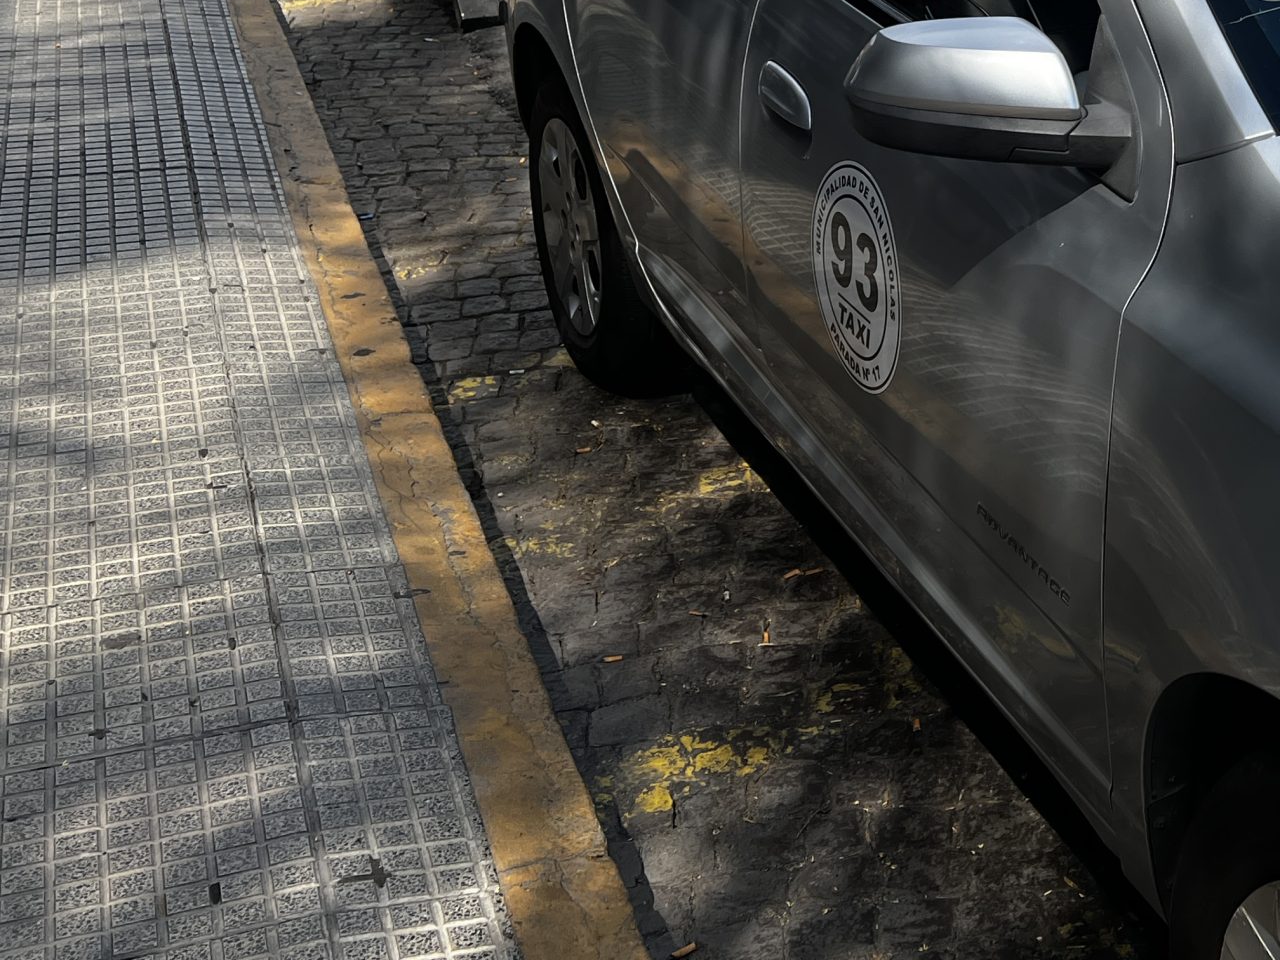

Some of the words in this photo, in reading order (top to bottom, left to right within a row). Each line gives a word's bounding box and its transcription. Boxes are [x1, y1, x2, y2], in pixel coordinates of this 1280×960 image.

[815, 175, 857, 256] MUNICIPALIDAD
[858, 180, 870, 200] DE
[869, 196, 884, 231] SAN
[882, 232, 896, 321] NICOLAS
[830, 211, 878, 313] 93
[830, 322, 861, 378] PARADA
[872, 364, 881, 382] 17
[838, 302, 871, 350] TAXI
[976, 503, 1071, 609] ADVANTAGE
